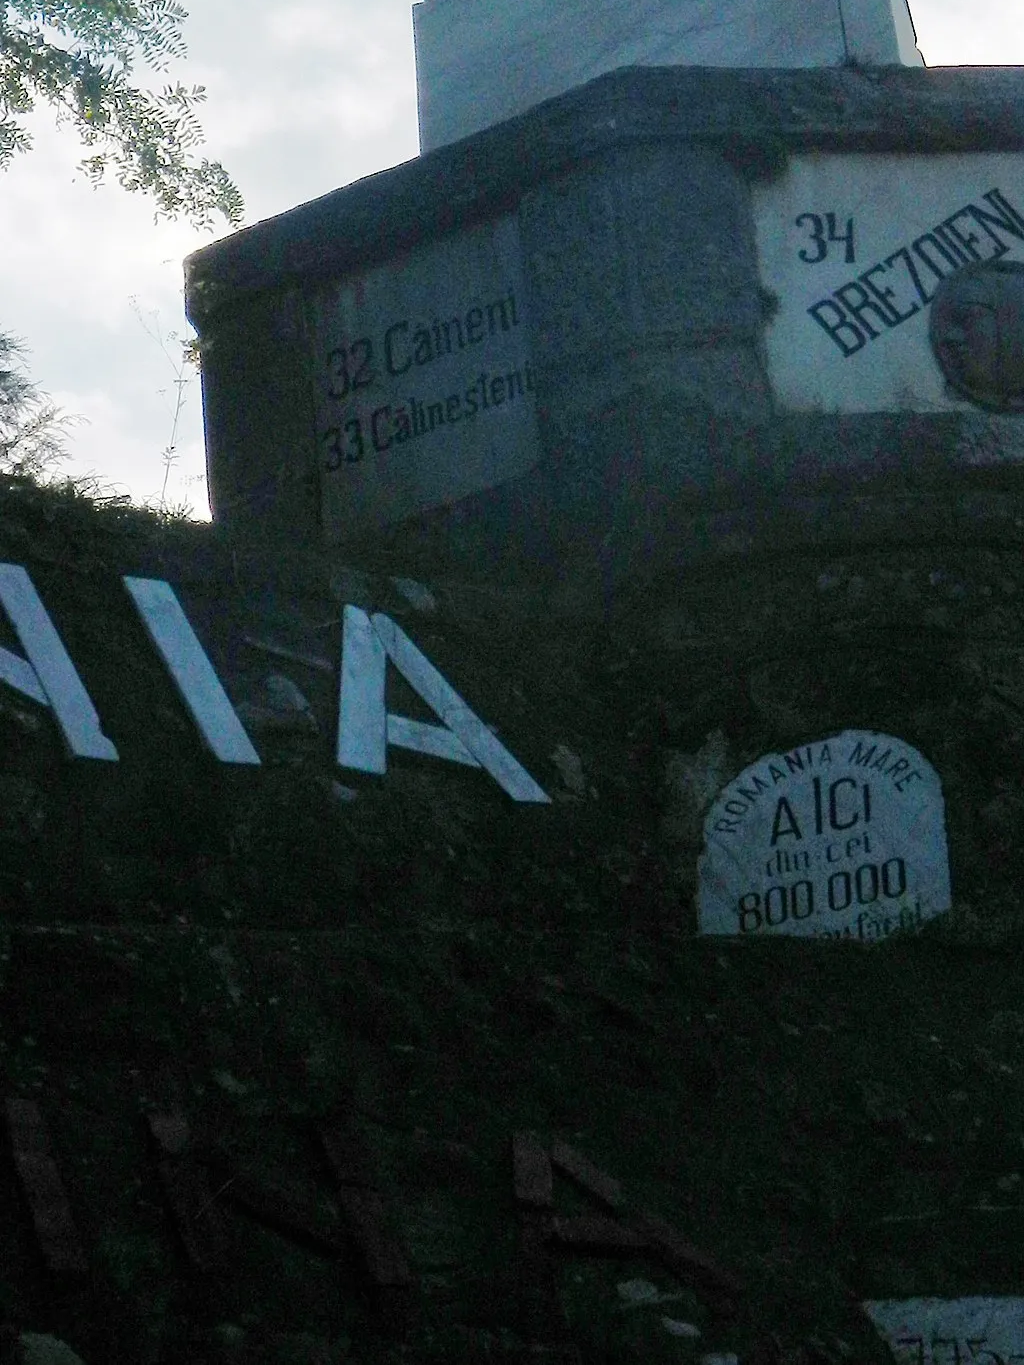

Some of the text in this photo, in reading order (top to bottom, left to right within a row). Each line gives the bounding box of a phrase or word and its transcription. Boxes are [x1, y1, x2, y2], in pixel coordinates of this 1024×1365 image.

[795, 212, 856, 264] 34
[326, 337, 374, 400] 32
[322, 419, 365, 472] 33
[848, 741, 923, 793] MARE
[769, 776, 871, 847] AICI
[765, 848, 811, 878] din
[738, 879, 814, 933] 800
[827, 859, 907, 912] 000
